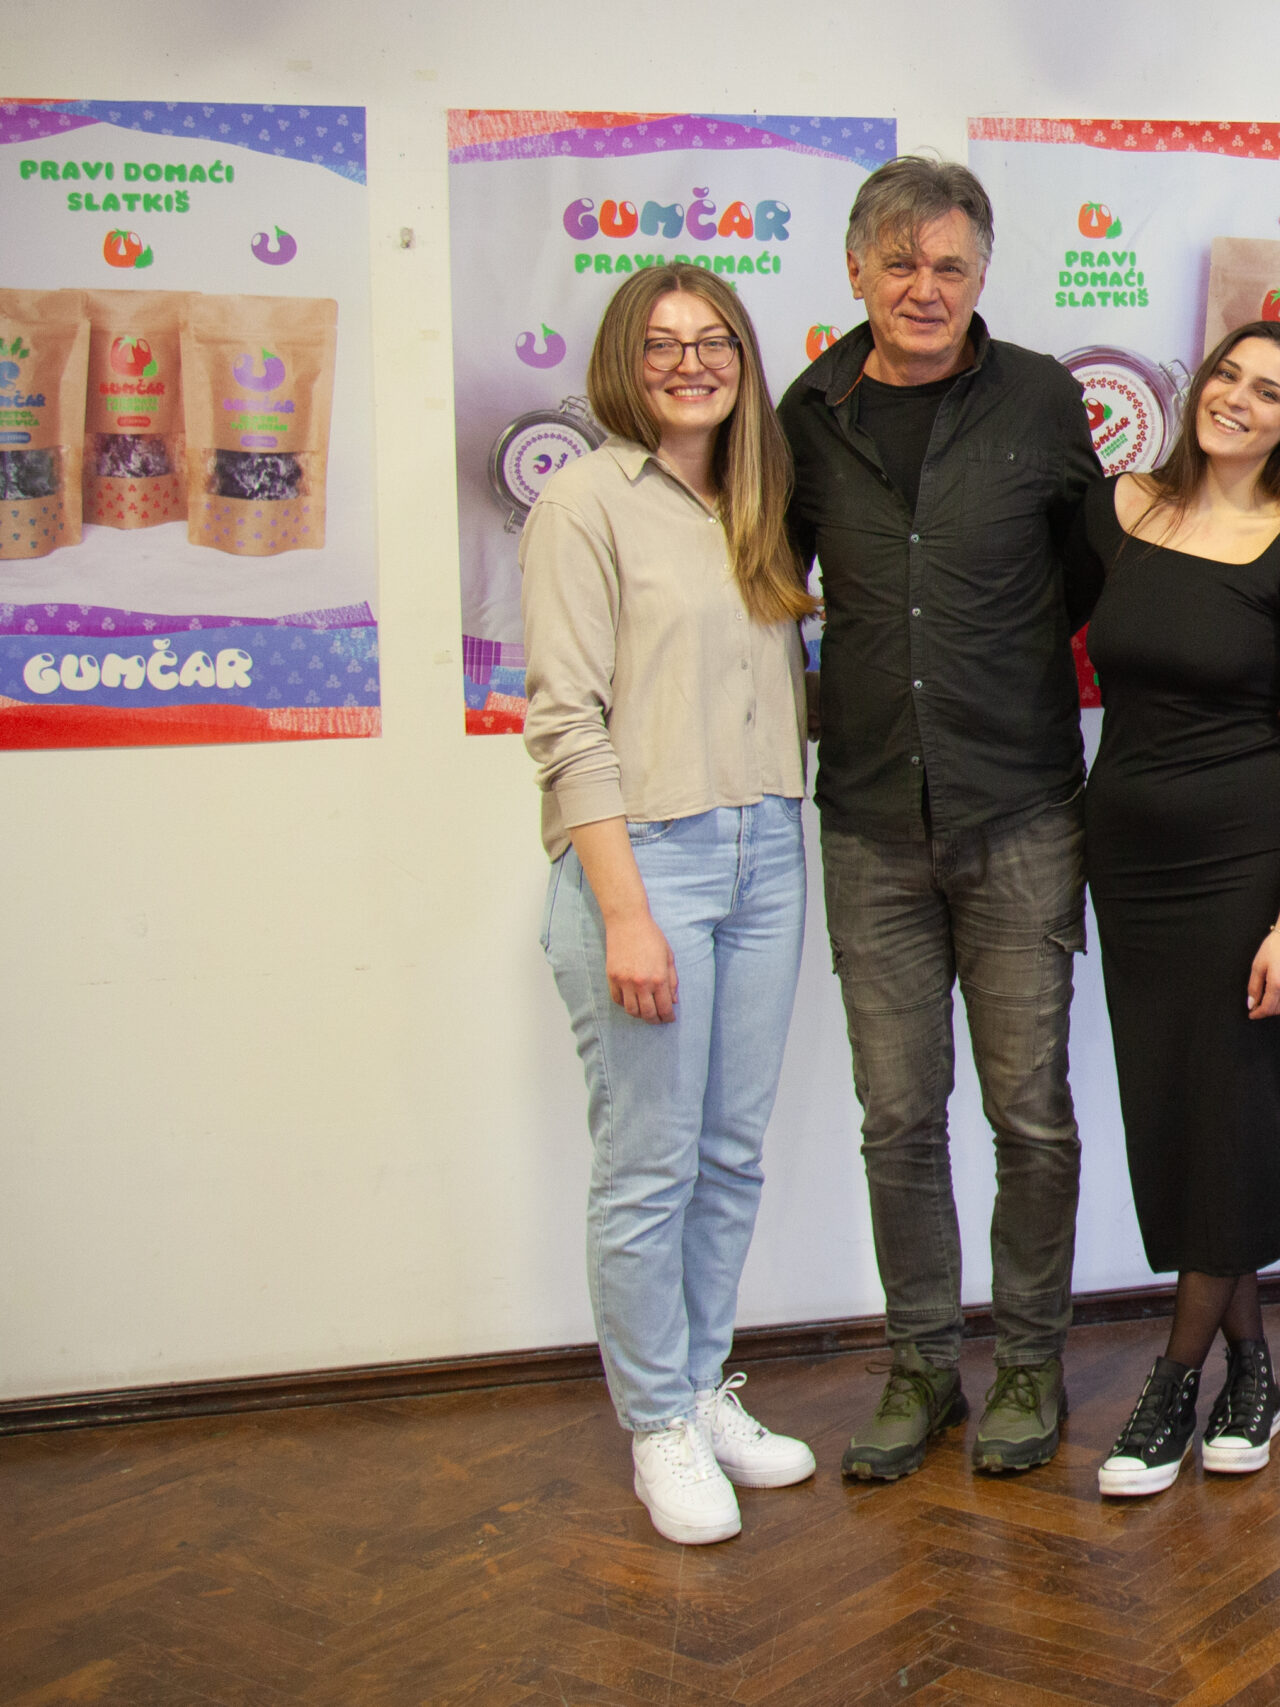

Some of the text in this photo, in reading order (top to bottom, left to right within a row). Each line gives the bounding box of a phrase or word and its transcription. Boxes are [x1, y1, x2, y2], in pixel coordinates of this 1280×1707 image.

[18, 159, 234, 184] PRAVI DOMAĆI
[67, 189, 190, 214] SLATKIŠ
[563, 187, 791, 241] GUMČAR
[1064, 250, 1137, 268] PRAVI
[1058, 267, 1145, 288] DOMAĆI
[1054, 287, 1149, 308] SLATKIŠ
[1092, 416, 1131, 451] UMČAR
[23, 637, 253, 694] GUMČAR
